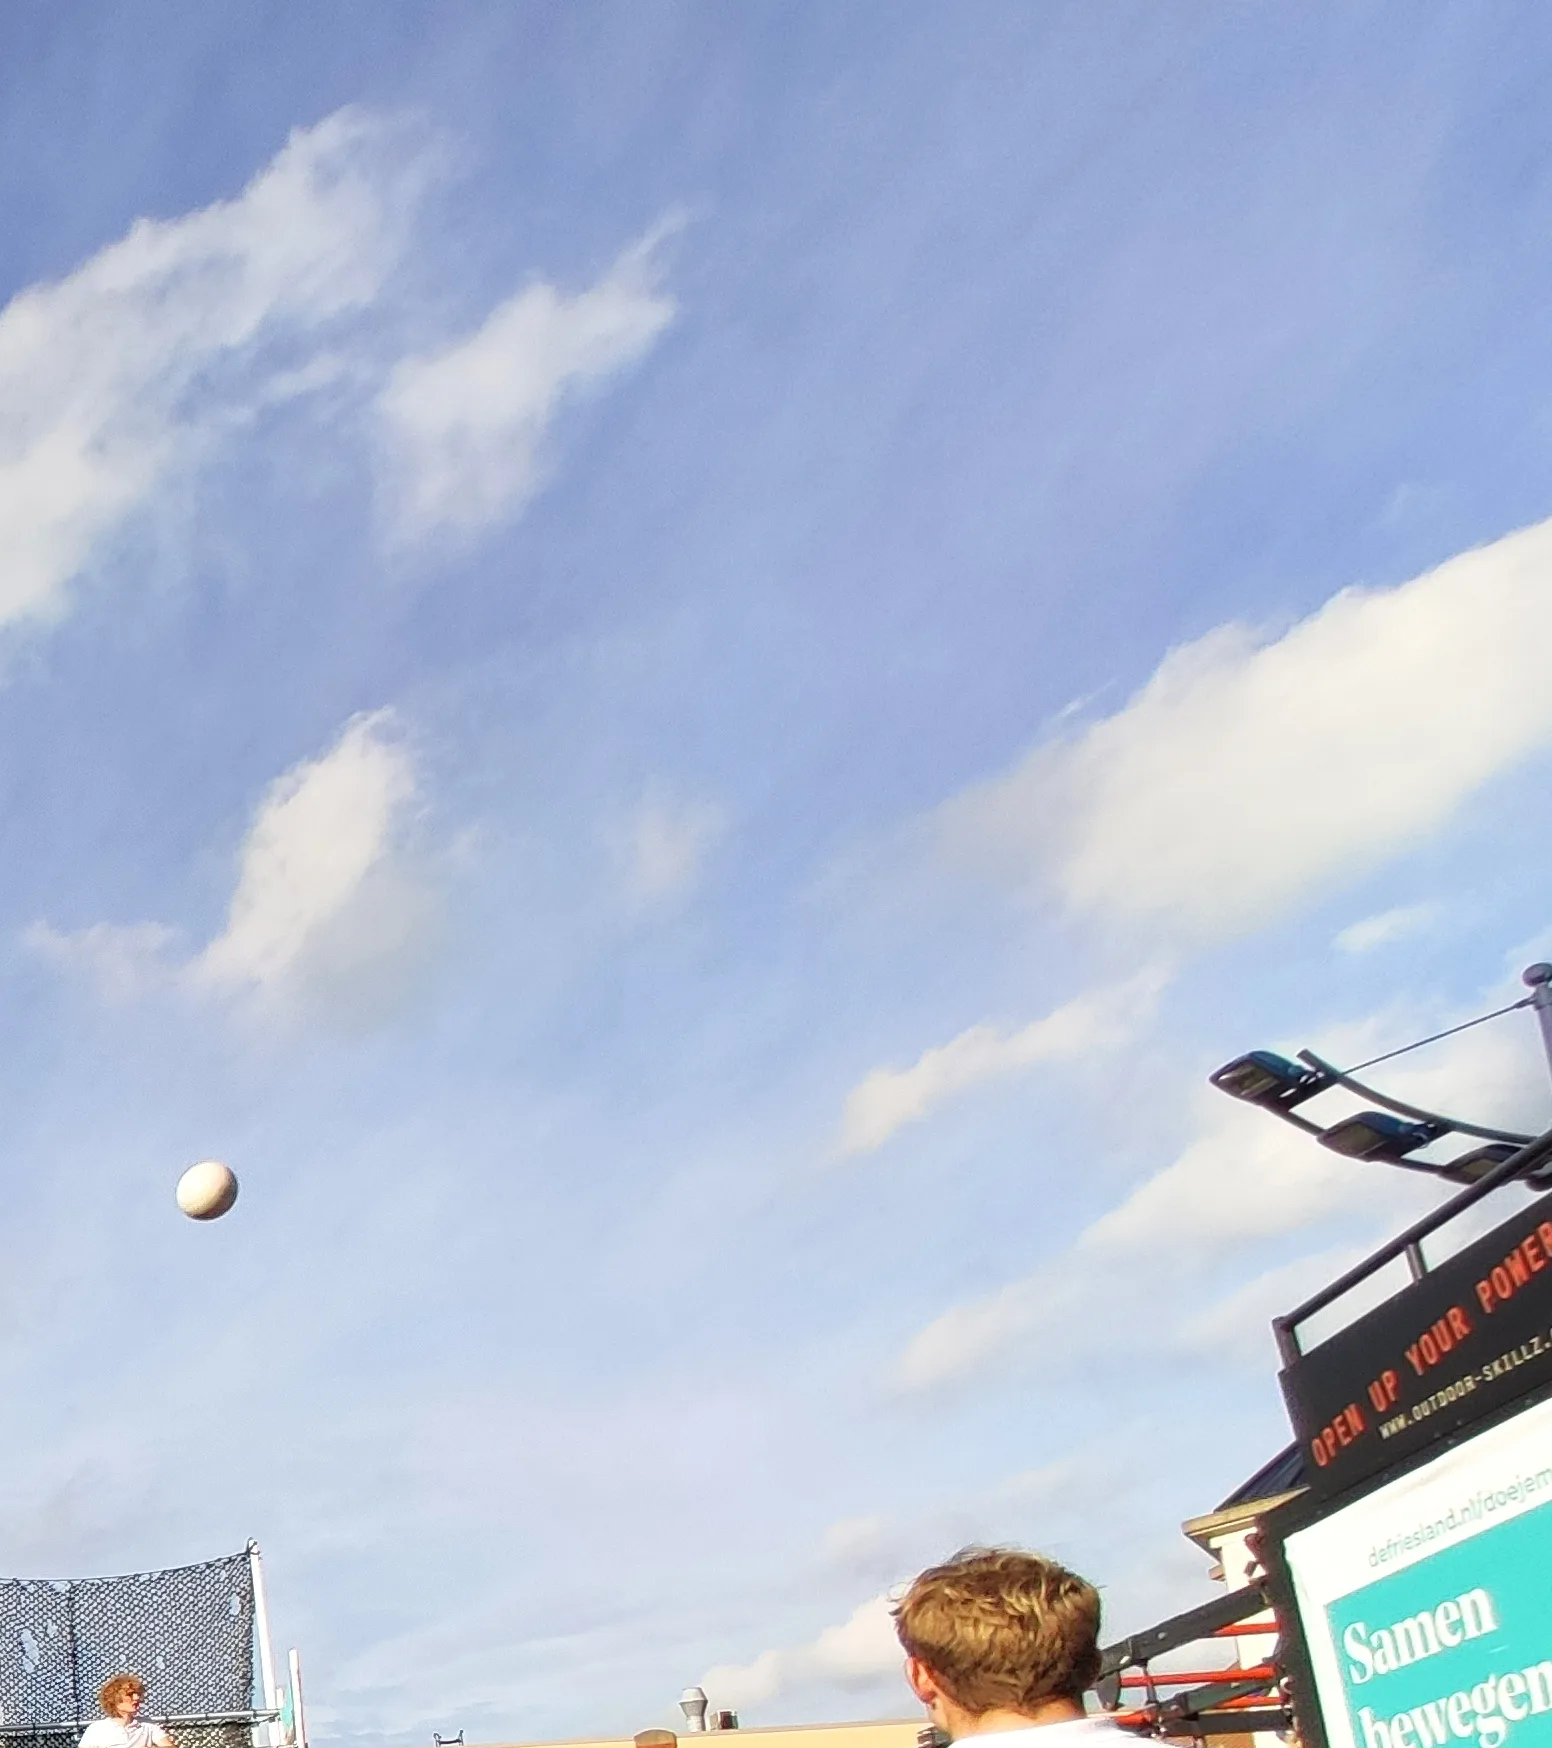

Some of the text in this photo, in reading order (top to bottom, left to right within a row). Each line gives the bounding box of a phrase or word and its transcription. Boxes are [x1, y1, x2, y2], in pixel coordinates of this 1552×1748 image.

[1312, 1404, 1365, 1467] OPEN
[1368, 1370, 1398, 1413] UP
[1404, 1306, 1471, 1376] YOUR
[1344, 1588, 1499, 1684] Samen
